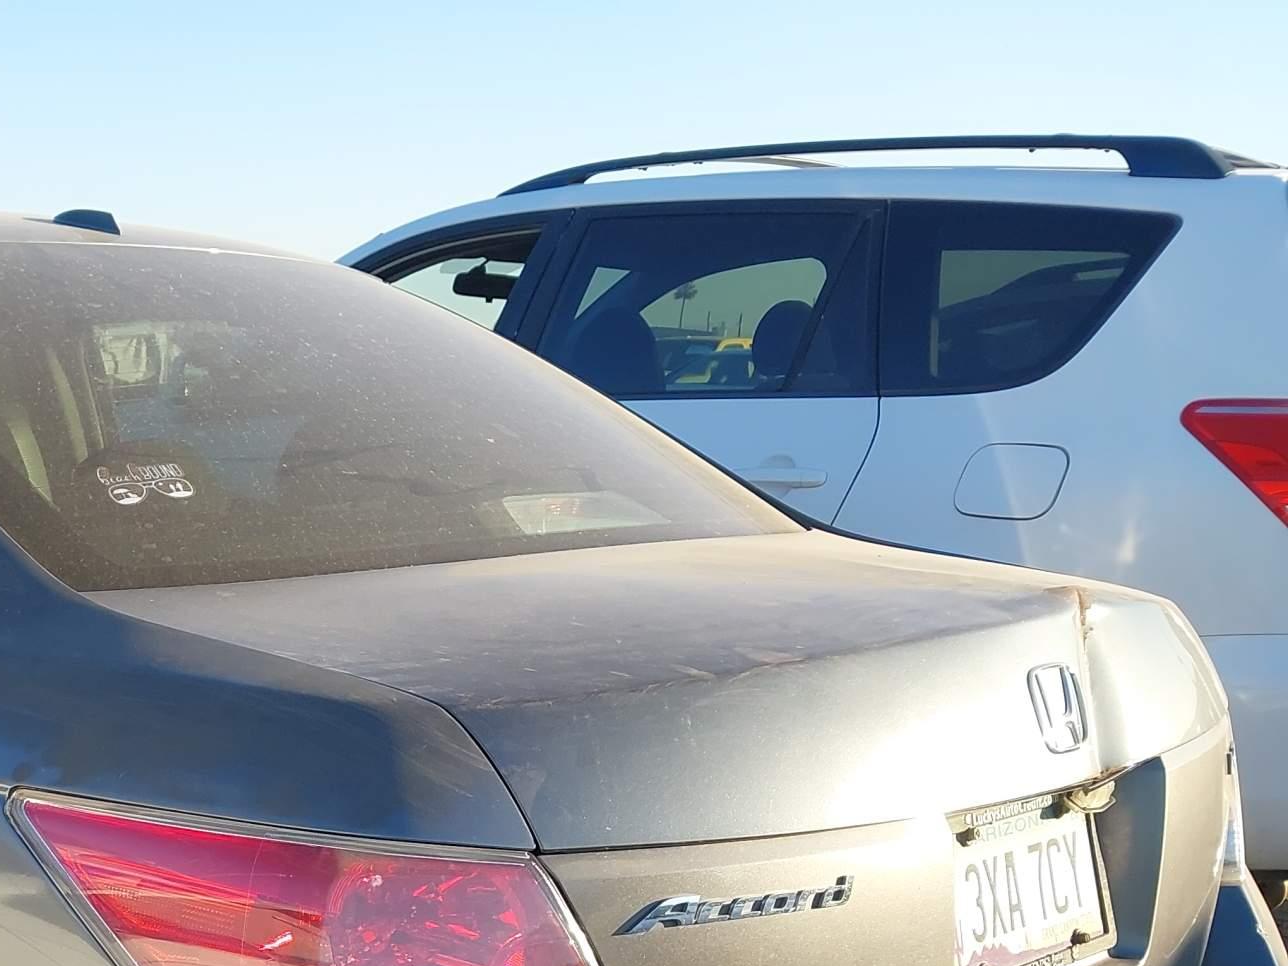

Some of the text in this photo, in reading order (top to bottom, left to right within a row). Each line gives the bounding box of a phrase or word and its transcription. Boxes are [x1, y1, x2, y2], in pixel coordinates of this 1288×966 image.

[611, 875, 855, 937] Accord
[964, 831, 1084, 944] 3XA 7CY
